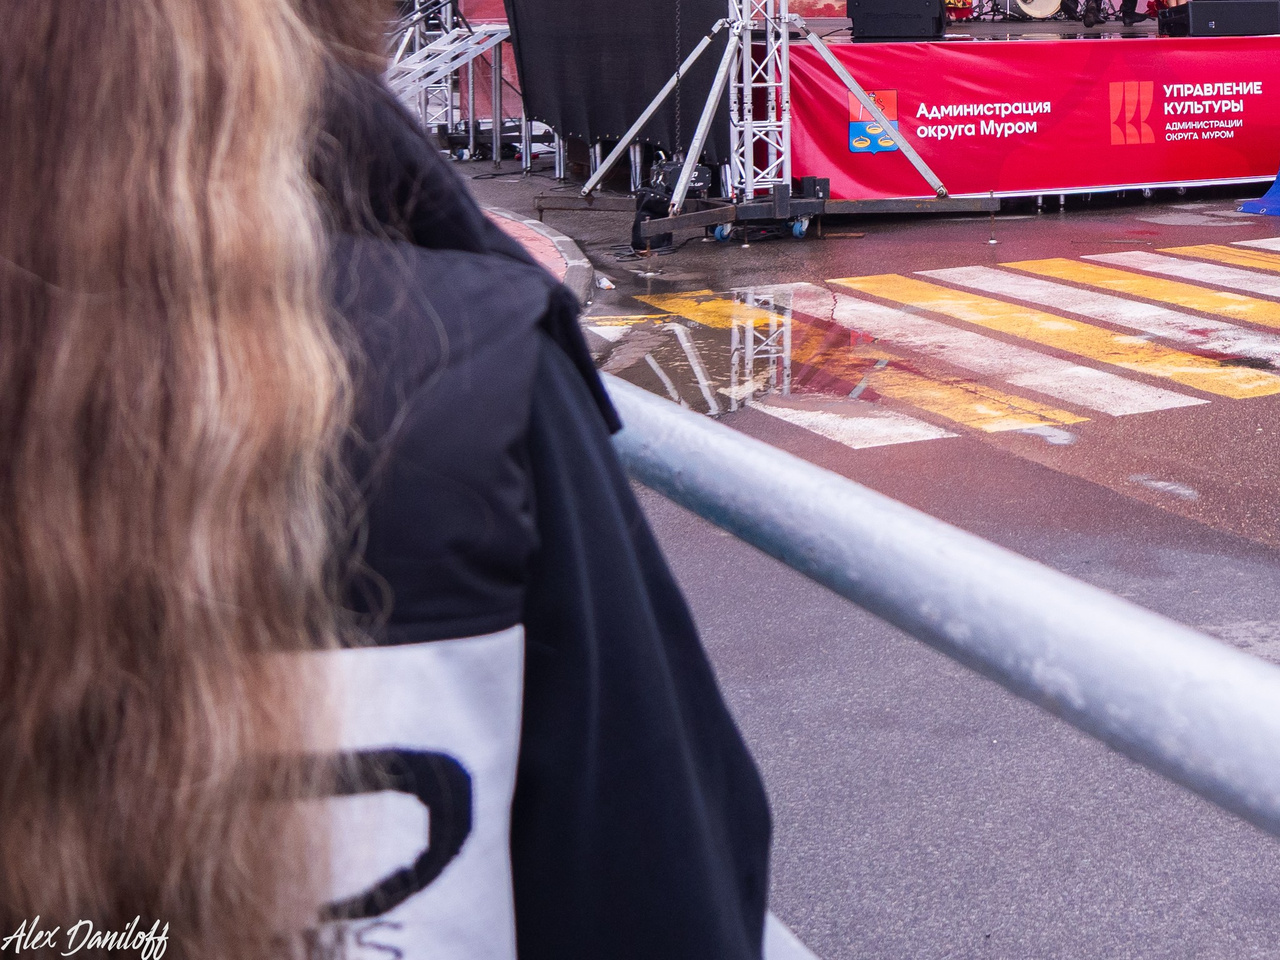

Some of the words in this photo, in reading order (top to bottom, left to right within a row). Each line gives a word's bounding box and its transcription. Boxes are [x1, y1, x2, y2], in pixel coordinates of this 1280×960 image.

[1163, 81, 1263, 98] УПРАВЛЕНИЕ
[915, 101, 1051, 121] Администрация
[1163, 99, 1244, 116] КУЛЬТУРЫ
[916, 123, 976, 141] округа
[980, 118, 1038, 138] Муром
[1165, 119, 1243, 131] АДМИНИСТРАЦИИ
[1165, 132, 1199, 141] ОКРУГА
[1201, 130, 1235, 140] МУРОМ
